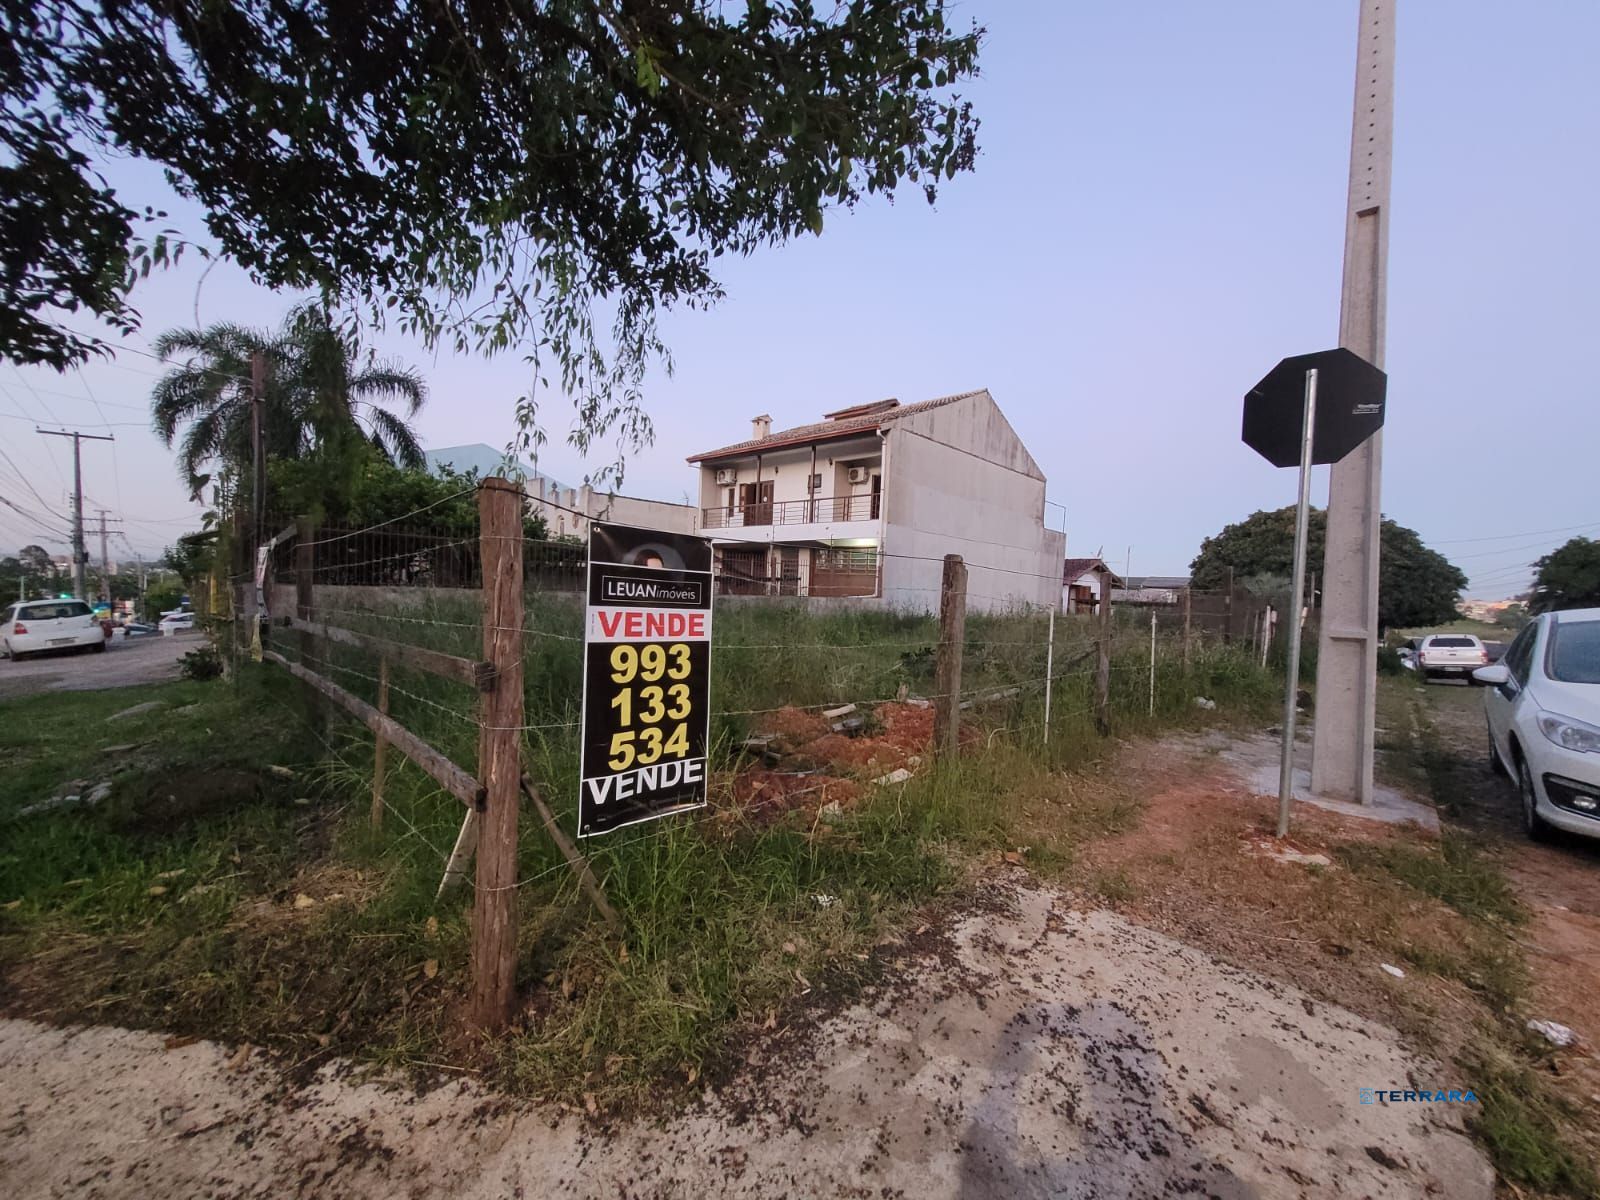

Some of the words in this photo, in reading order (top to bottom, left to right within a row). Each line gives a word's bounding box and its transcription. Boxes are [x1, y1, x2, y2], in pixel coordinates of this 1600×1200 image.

[598, 611, 705, 637] VENDE
[610, 643, 692, 684] 993
[611, 683, 692, 727] 133
[608, 722, 690, 771] 534
[588, 760, 703, 805] VENDE
